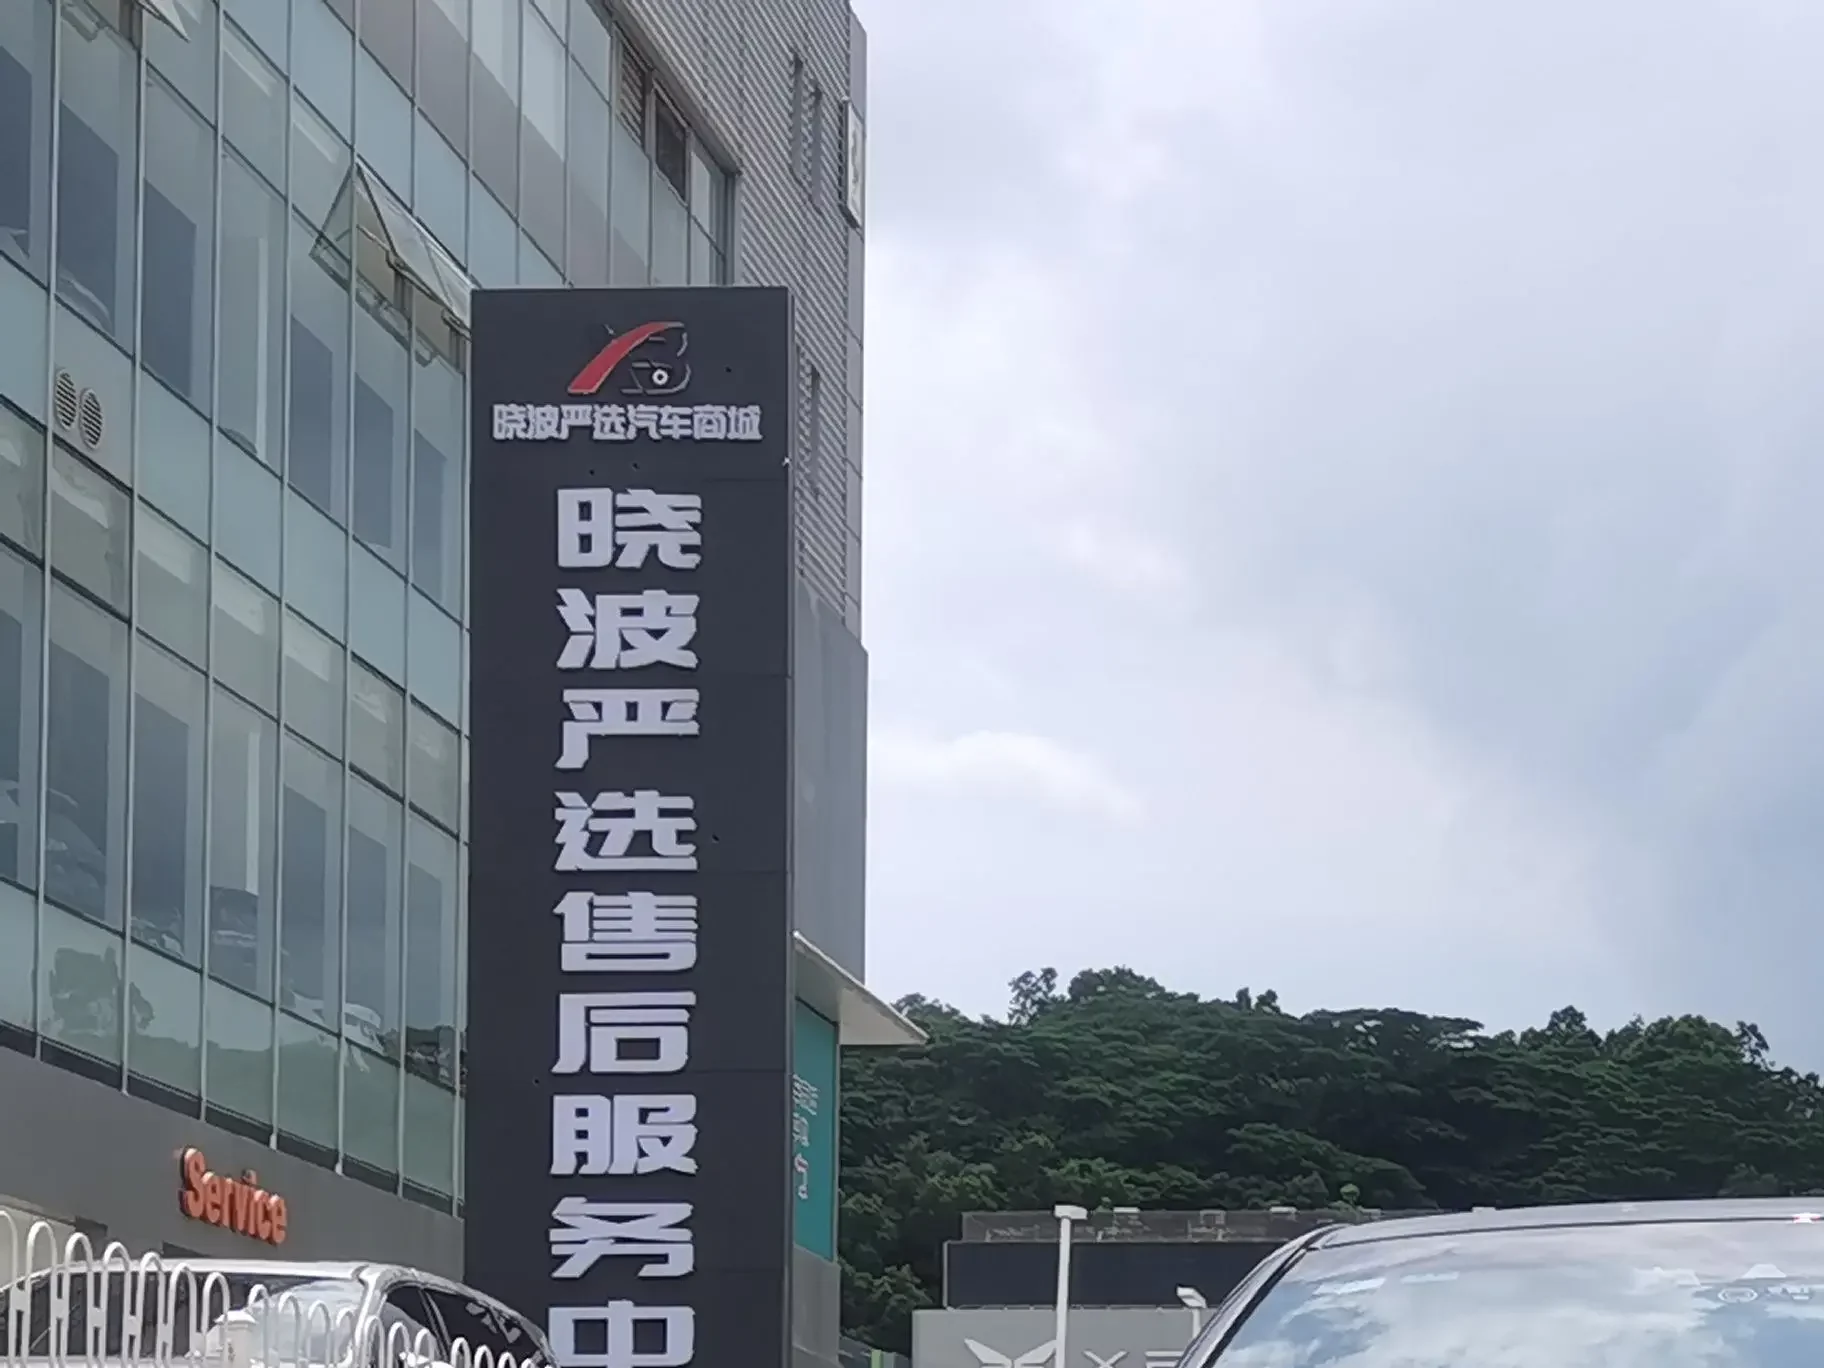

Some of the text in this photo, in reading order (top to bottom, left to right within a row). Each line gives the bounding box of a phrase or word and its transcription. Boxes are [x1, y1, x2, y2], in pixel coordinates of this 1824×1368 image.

[492, 403, 763, 440] 晓波严选汽车商城
[182, 1147, 288, 1246] Service
